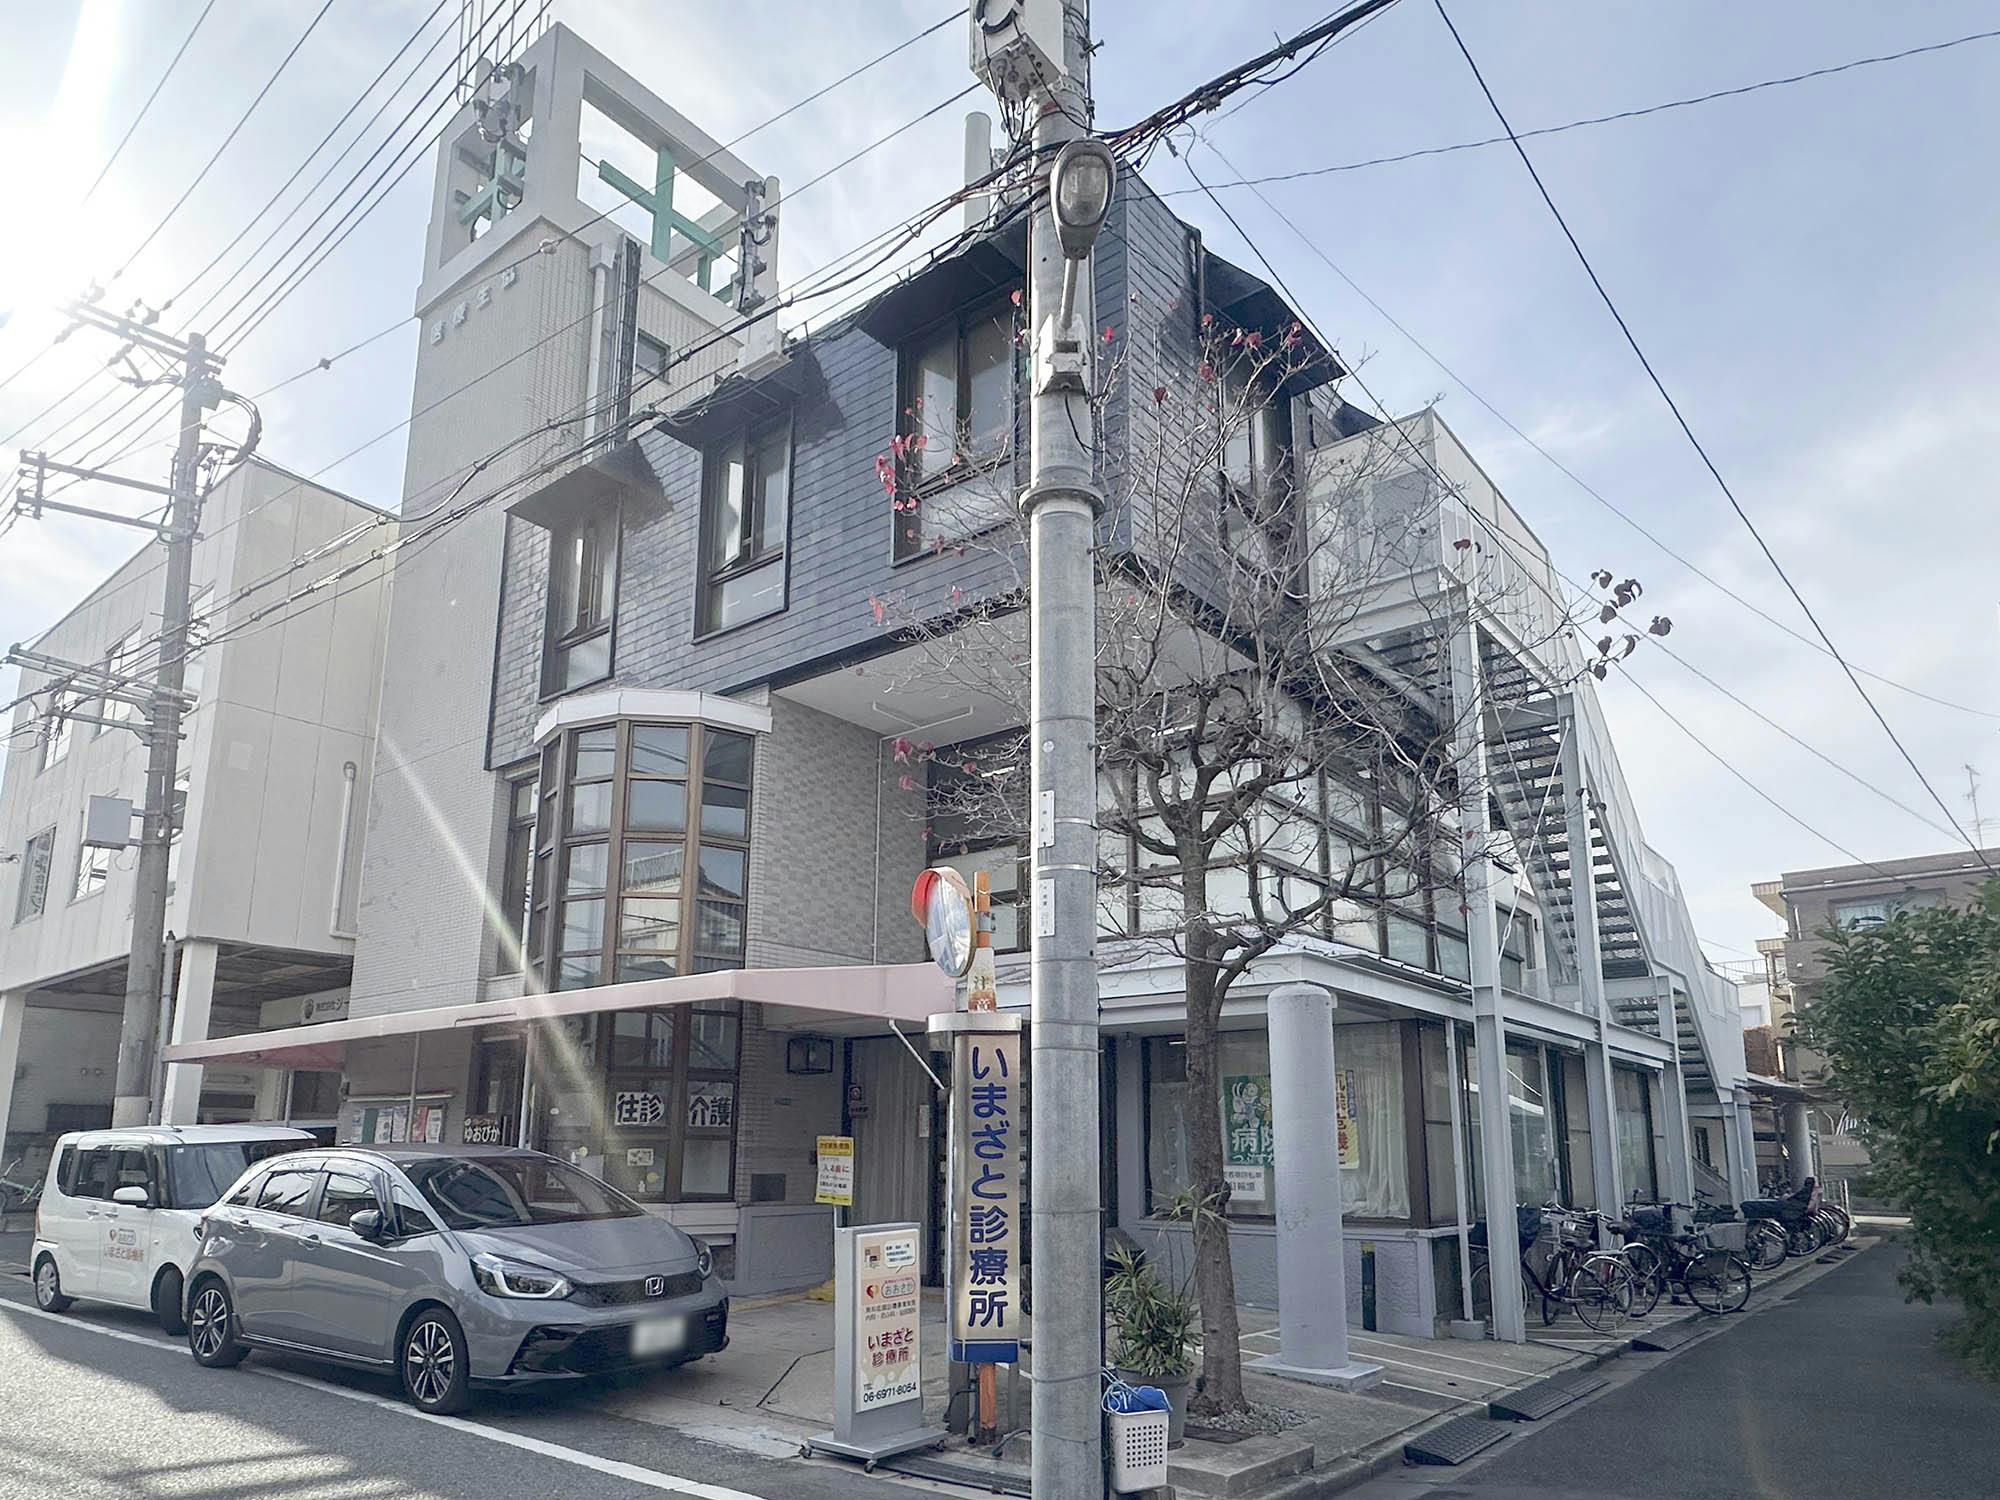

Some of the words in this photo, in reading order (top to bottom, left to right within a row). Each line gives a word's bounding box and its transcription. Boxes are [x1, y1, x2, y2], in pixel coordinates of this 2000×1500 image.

[616, 1093, 663, 1124] 往診
[688, 1096, 732, 1127] 介護
[968, 1045, 1010, 1328] いまざと診療所
[867, 1326, 914, 1351] いまざと
[872, 1346, 909, 1368] 診療所
